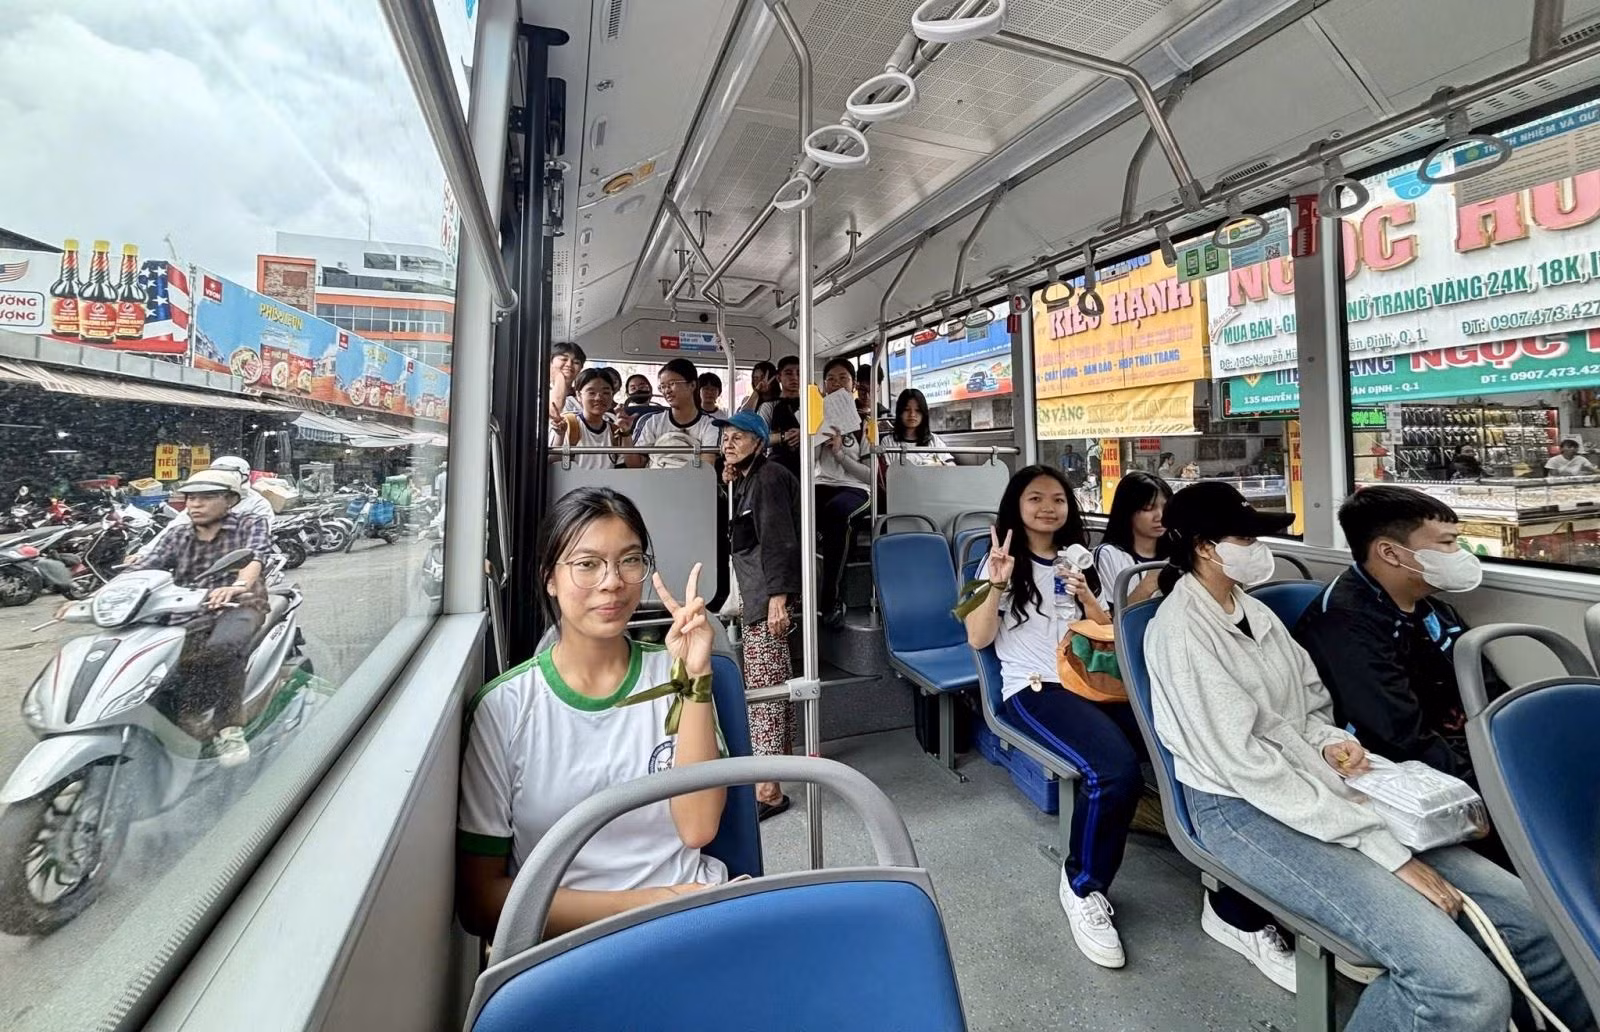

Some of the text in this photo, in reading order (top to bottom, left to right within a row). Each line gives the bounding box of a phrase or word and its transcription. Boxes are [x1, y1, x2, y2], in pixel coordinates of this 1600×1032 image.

[1223, 323, 1248, 345] MUA
[1373, 286, 1428, 317] TRANG
[1431, 277, 1483, 305] VÀNG
